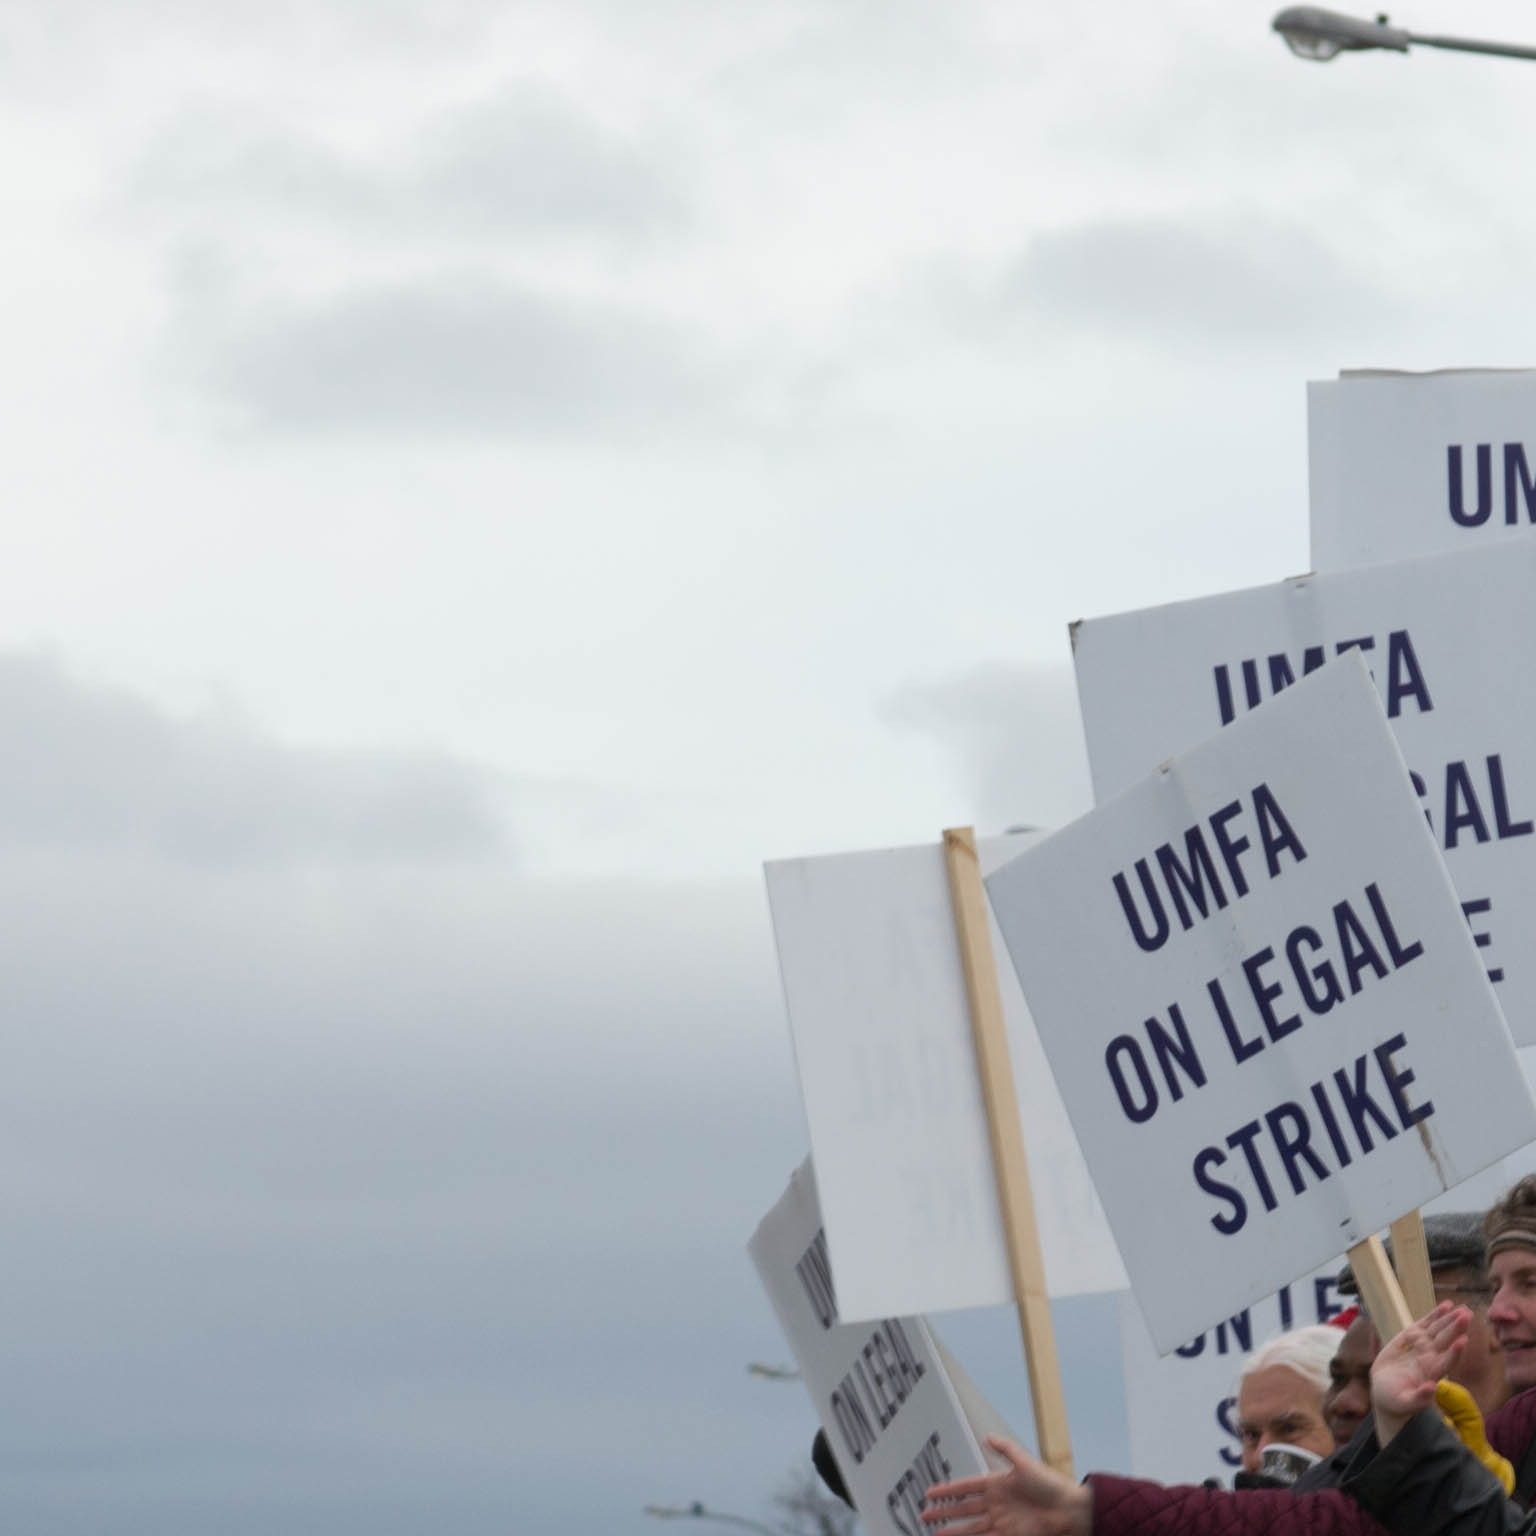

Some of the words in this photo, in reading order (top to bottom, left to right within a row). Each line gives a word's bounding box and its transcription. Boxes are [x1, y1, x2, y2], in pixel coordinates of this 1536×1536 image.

[1112, 782, 1308, 953] UMFA
[1105, 1003, 1208, 1124] ON
[1206, 882, 1424, 1065] LEGAL
[1193, 1032, 1435, 1237] STRIKE
